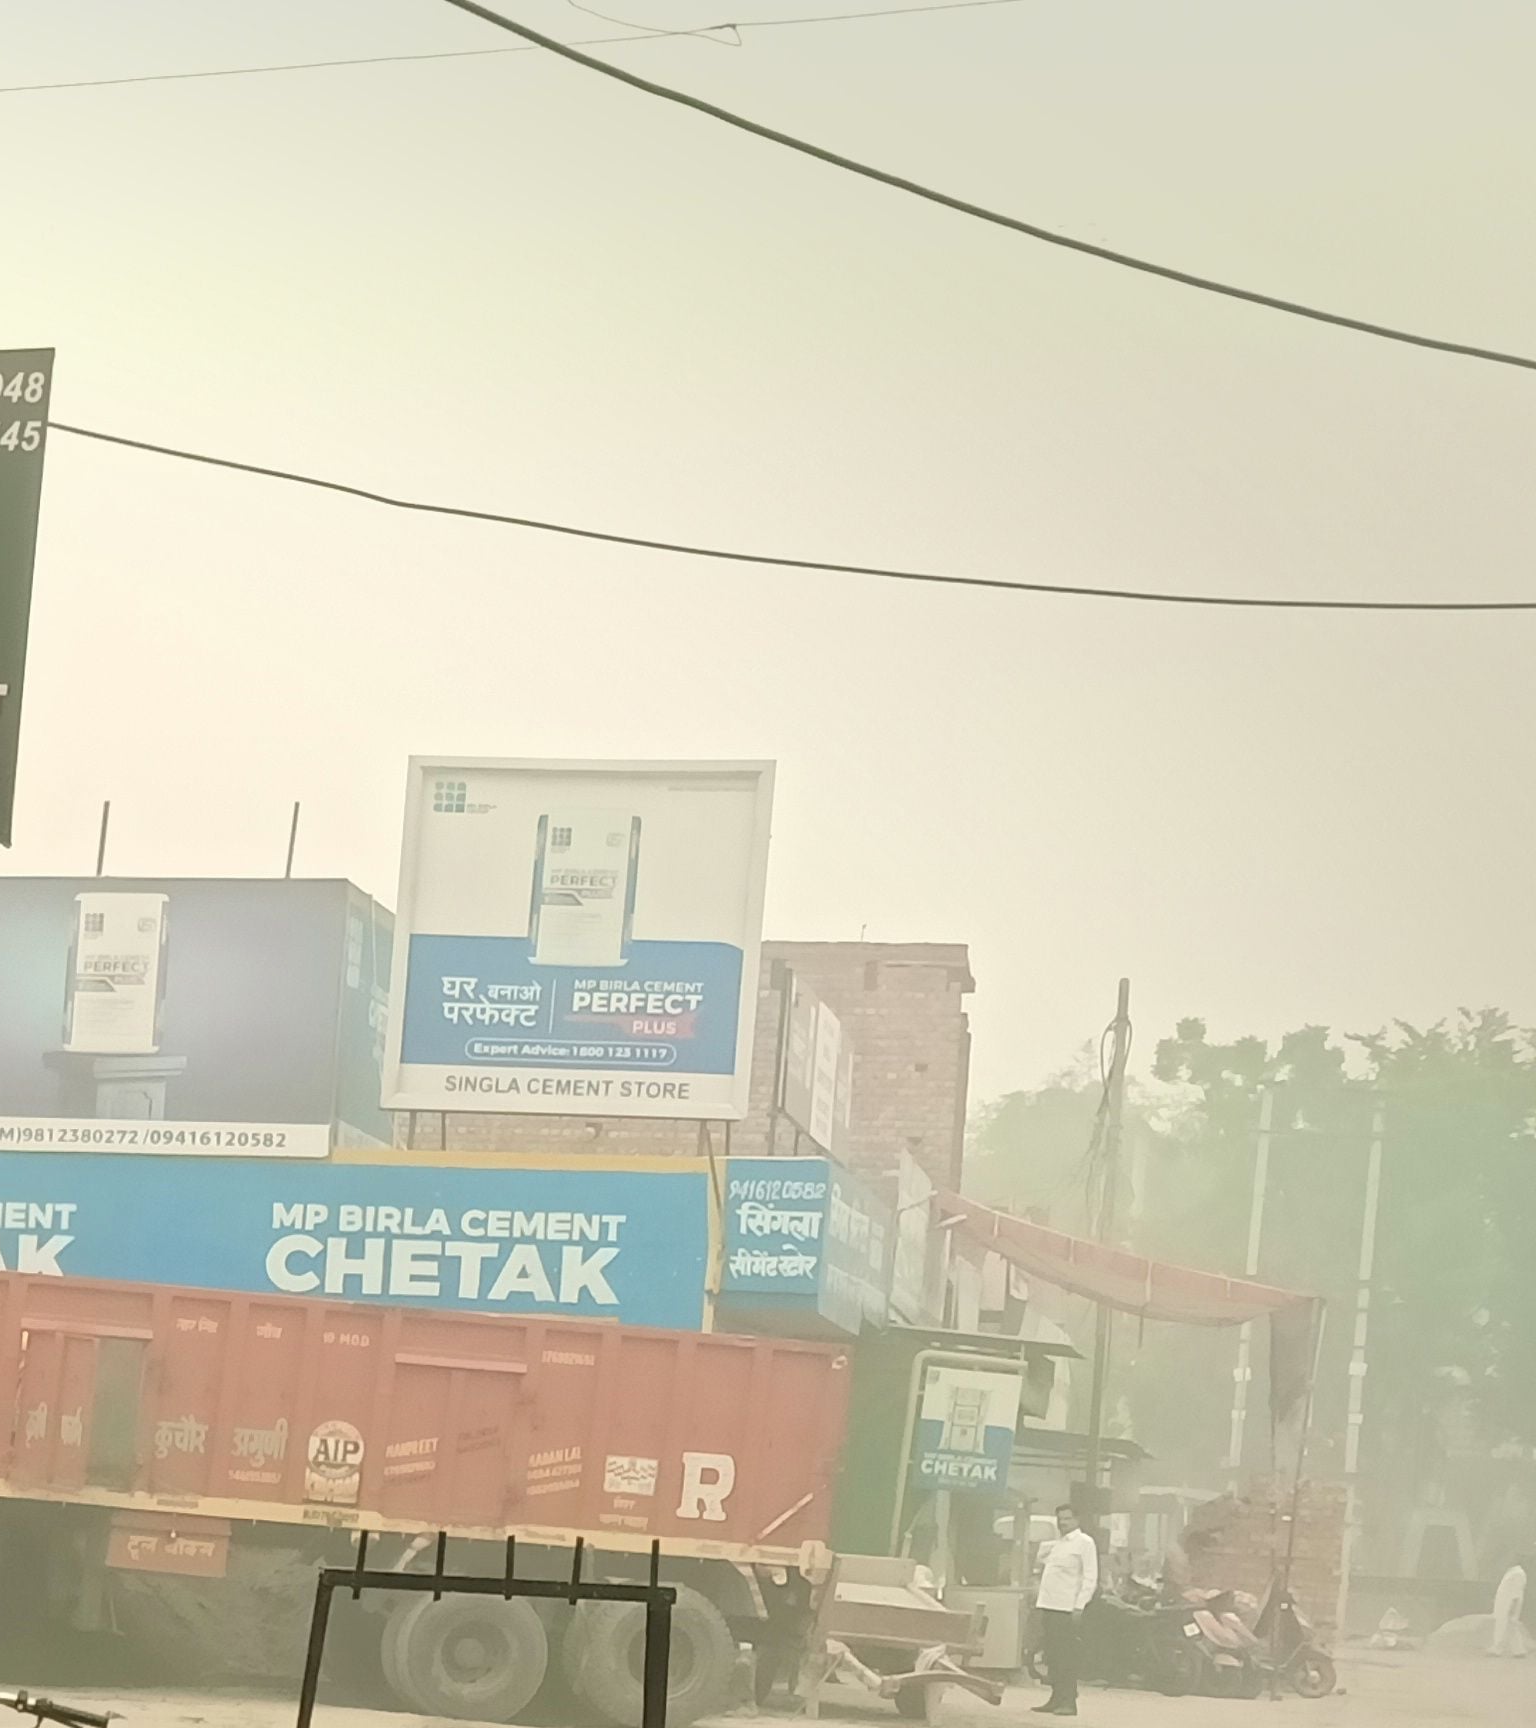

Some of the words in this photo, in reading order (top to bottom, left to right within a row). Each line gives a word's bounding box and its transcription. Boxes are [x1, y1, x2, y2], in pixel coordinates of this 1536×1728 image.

[441, 977, 478, 1001] घर
[574, 980, 596, 991] MP
[599, 980, 641, 992] BIRLA
[644, 981, 704, 993] CEMENT
[442, 993, 539, 1027] परफेक्ट
[572, 992, 703, 1015] PERFECT
[633, 1020, 677, 1035] PLUS
[474, 1043, 519, 1057] Expert
[572, 1046, 604, 1058] 1800
[445, 1075, 520, 1094] SINGLA
[528, 1078, 613, 1097] CEMENT
[620, 1080, 690, 1100] STORE
[273, 1203, 328, 1231] MP
[338, 1206, 449, 1236] BIRLA
[460, 1210, 626, 1241] CEMENT
[736, 1201, 823, 1241] सिंगला
[265, 1234, 621, 1305] CHETAK
[314, 1438, 360, 1463] AIP
[921, 1459, 997, 1481] CHETAK
[675, 1451, 735, 1521] R
